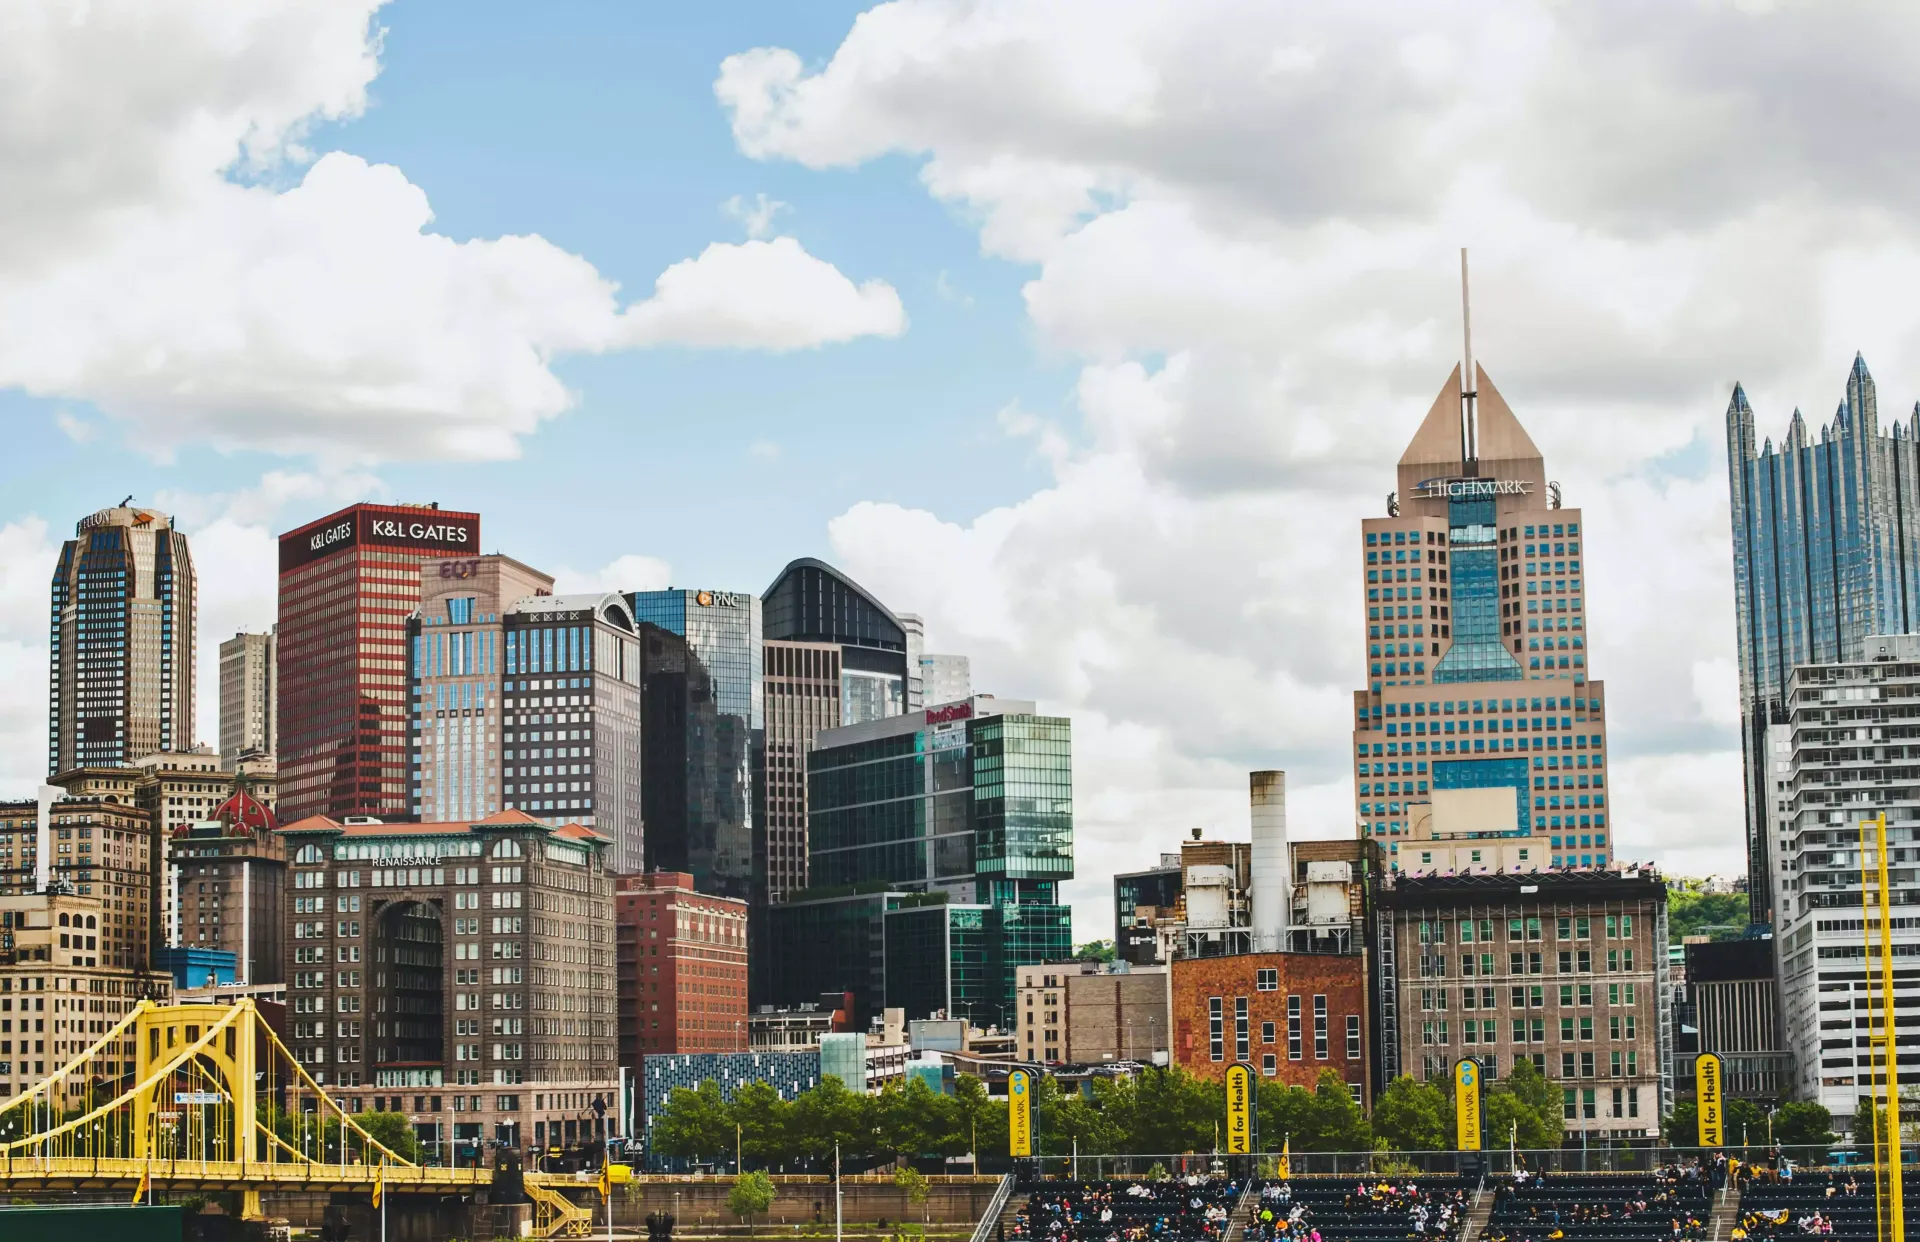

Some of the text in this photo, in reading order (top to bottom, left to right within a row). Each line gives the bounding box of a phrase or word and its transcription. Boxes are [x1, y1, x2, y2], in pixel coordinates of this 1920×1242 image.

[1429, 479, 1526, 498] HIGHMARK
[310, 522, 351, 550] K&L GATES
[372, 519, 468, 543] K&L GATES
[440, 560, 480, 580] EQT
[713, 594, 740, 607] PNC
[372, 857, 442, 867] RENAISSANCE
[1232, 1073, 1245, 1153] All for Health
[1702, 1061, 1717, 1145] All for Health
